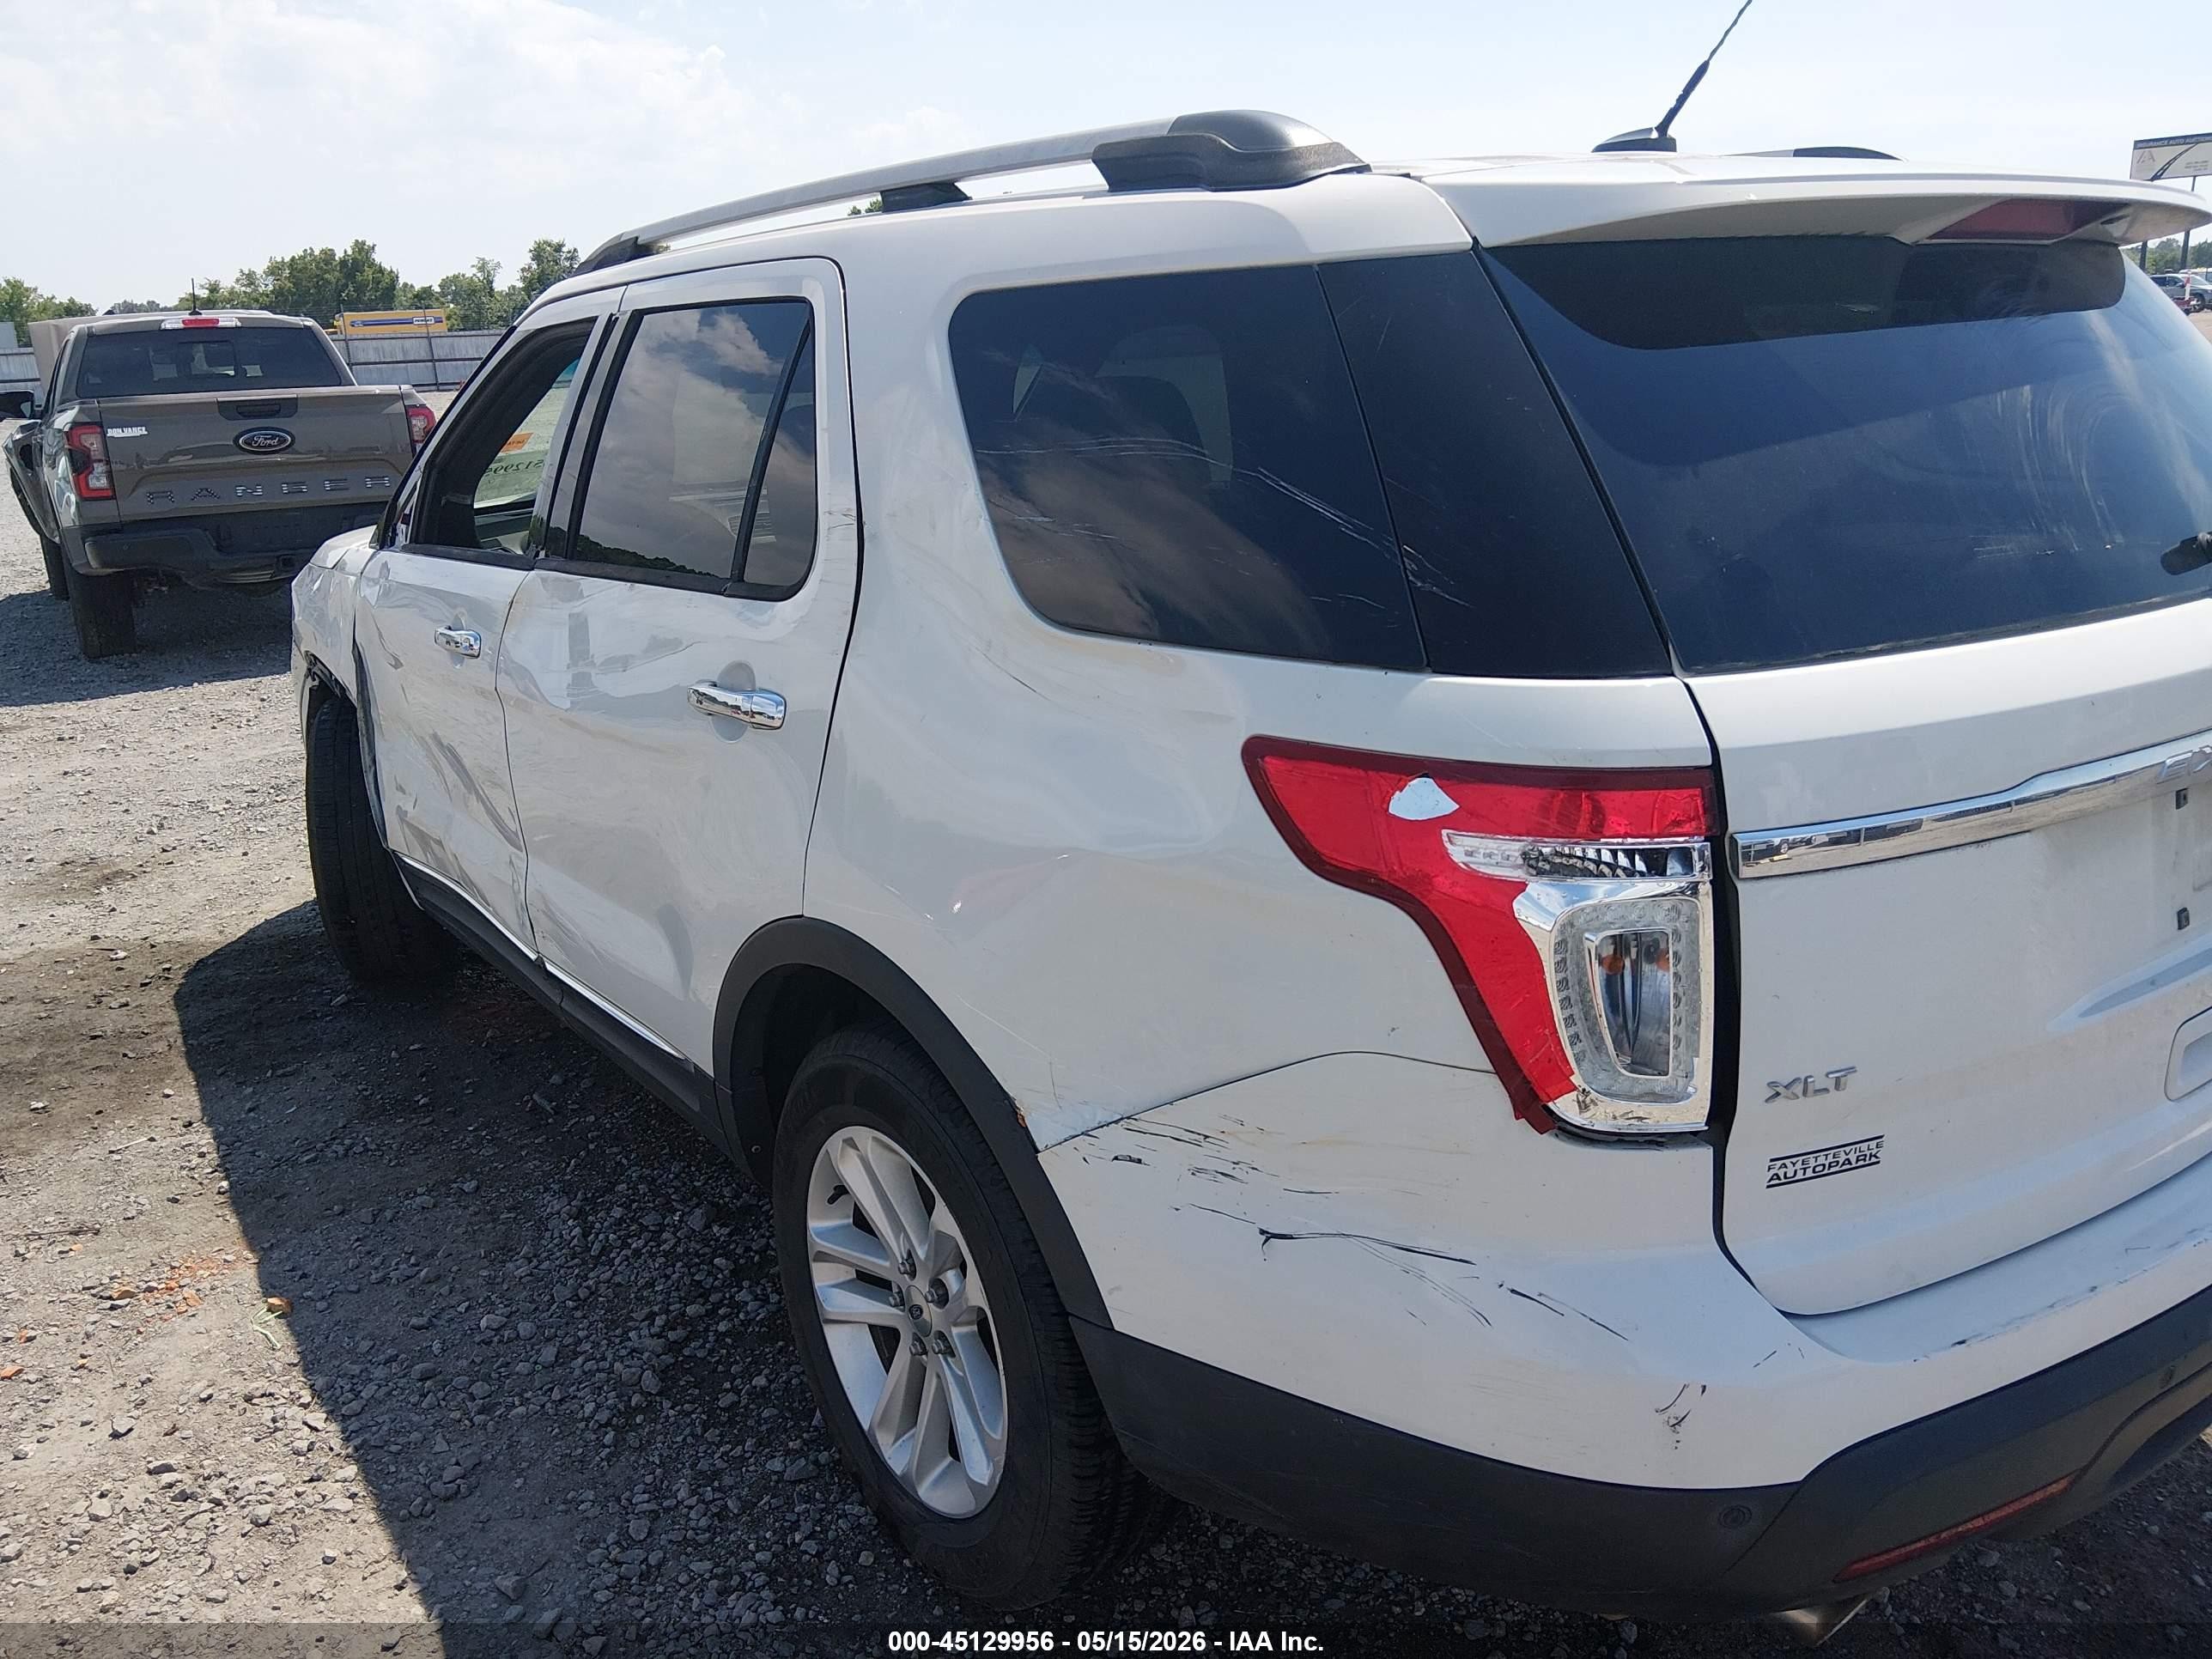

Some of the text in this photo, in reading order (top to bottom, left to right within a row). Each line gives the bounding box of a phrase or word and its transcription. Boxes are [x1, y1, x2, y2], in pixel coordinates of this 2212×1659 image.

[147, 477, 391, 505] RANGER
[1765, 1066, 1857, 1103] XLT
[1766, 1150, 1882, 1183] AUTOPARK
[1767, 1140, 1885, 1172] FAYETTEVILLE
